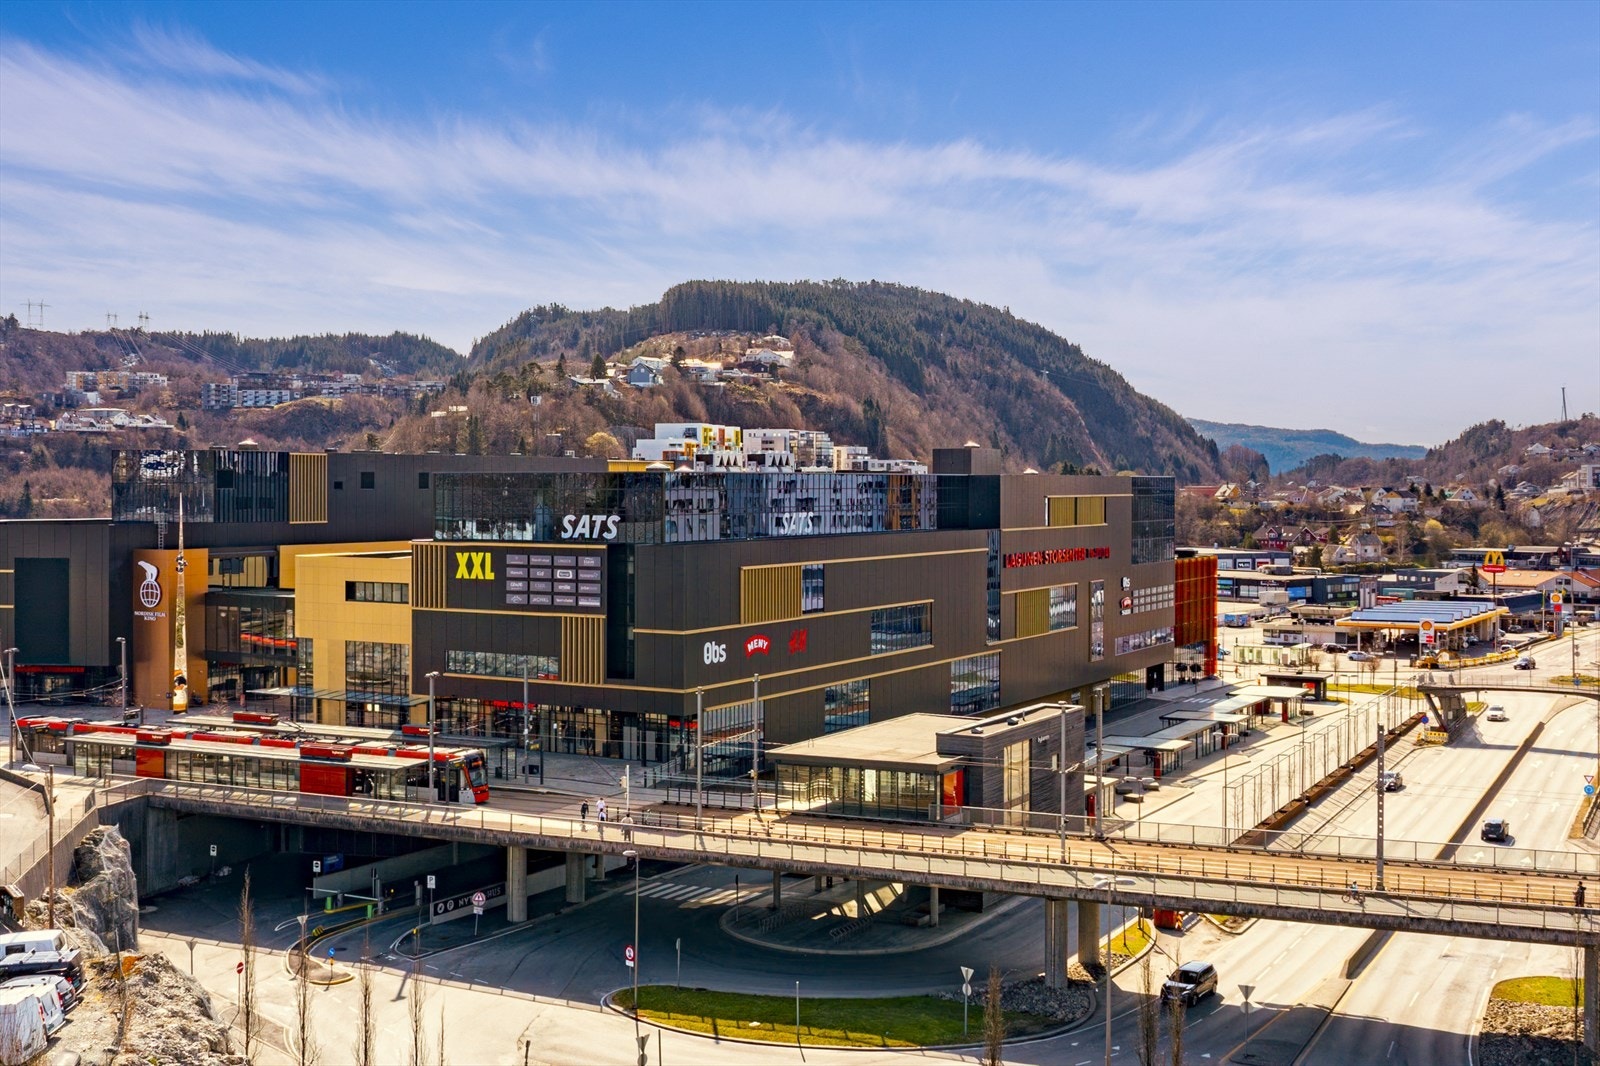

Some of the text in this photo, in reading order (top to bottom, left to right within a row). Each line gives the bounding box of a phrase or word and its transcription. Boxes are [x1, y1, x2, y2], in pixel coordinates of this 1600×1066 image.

[561, 514, 621, 540] SATS
[780, 512, 814, 535] SATS
[455, 552, 495, 580] XXL
[1004, 551, 1043, 568] LAGUNEN
[703, 641, 727, 665] Obs
[747, 638, 768, 652] MENY
